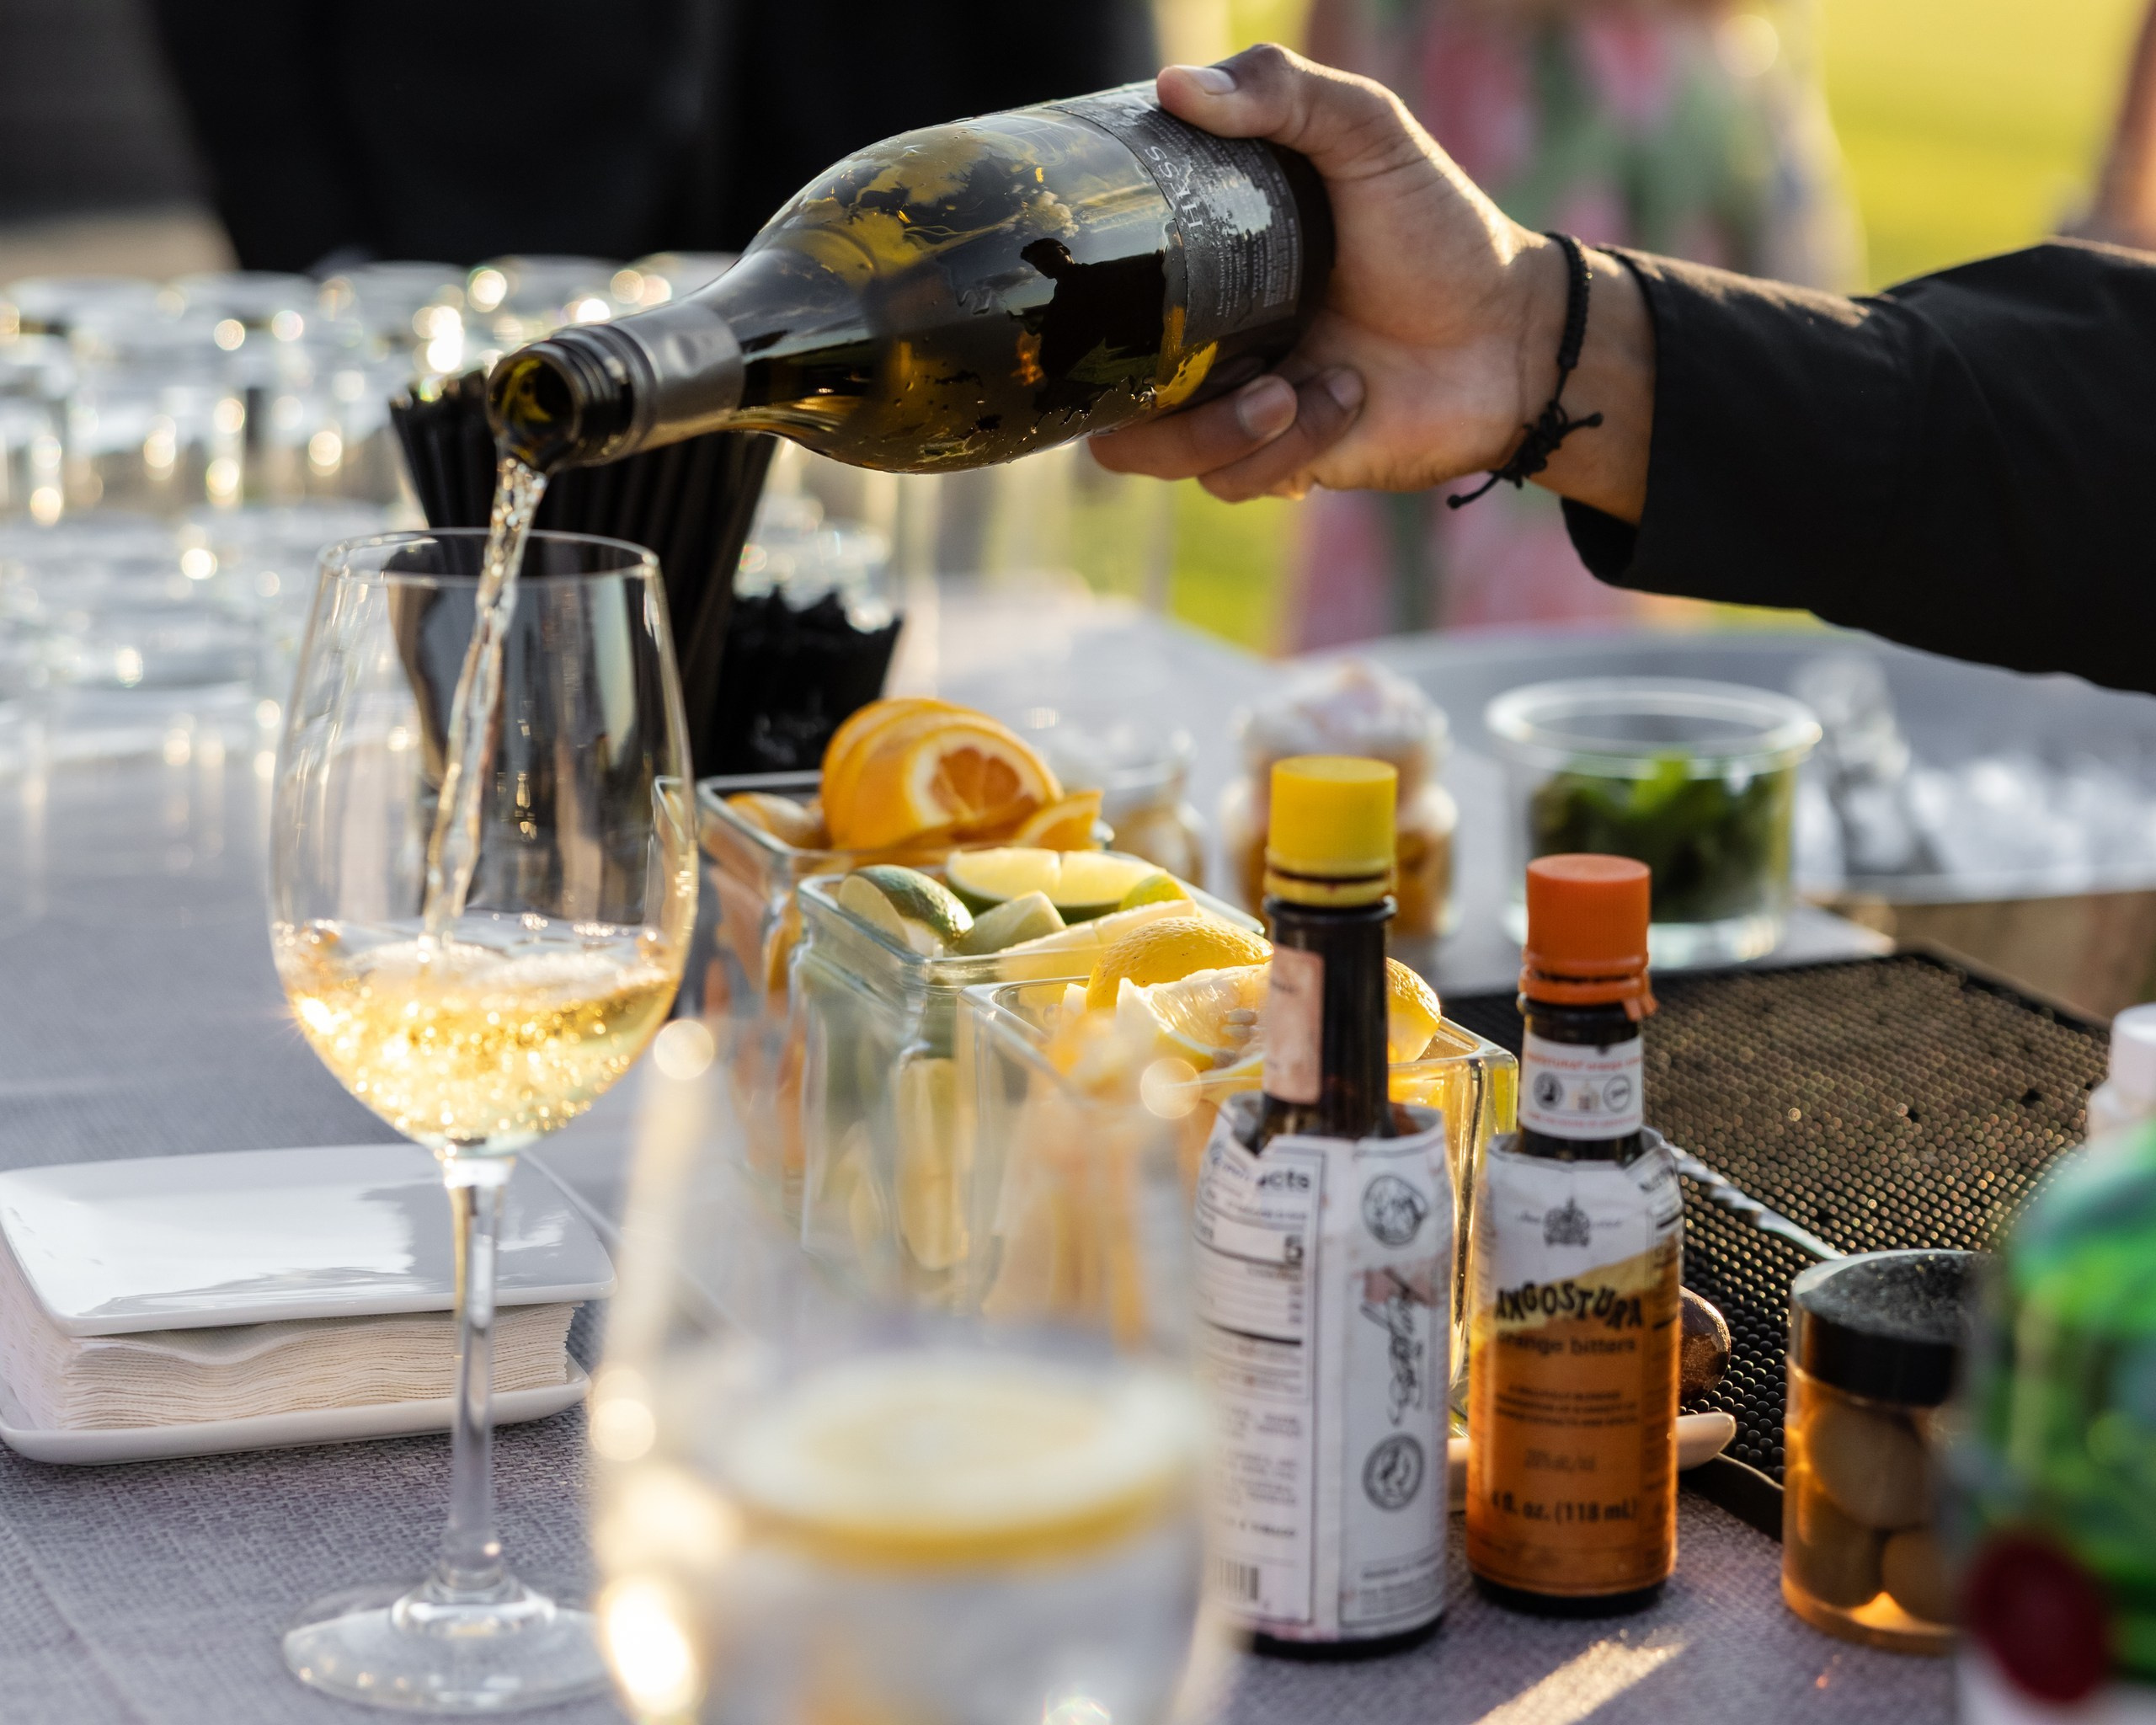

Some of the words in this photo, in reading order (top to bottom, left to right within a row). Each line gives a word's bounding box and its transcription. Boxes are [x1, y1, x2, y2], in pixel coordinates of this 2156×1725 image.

[1145, 146, 1203, 229] HESS
[1216, 291, 1225, 316] Hess
[1496, 1280, 1644, 1329] ANGOSTURA
[1570, 1337, 1636, 1355] bitters
